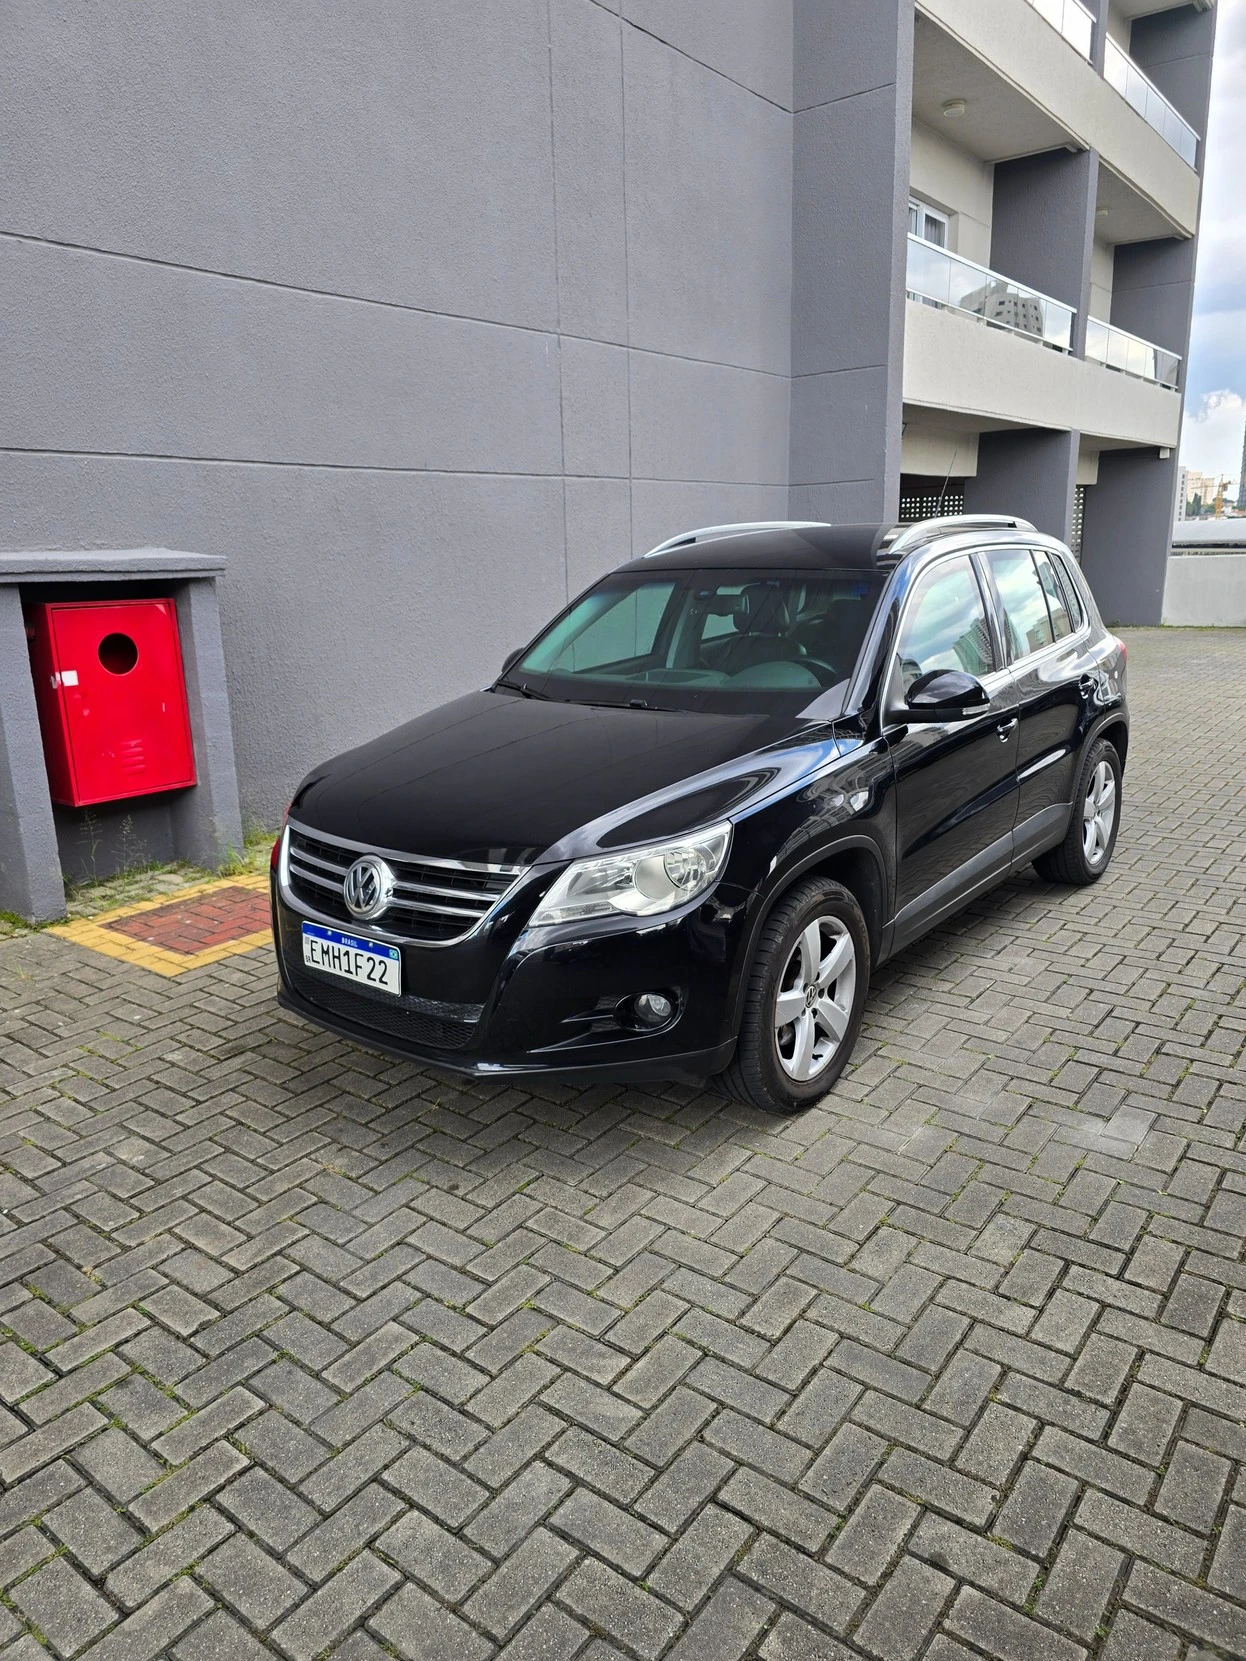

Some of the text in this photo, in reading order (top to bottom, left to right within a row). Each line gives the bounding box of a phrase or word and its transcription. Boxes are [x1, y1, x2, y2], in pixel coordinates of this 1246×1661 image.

[348, 864, 379, 911] VW
[310, 939, 388, 985] EMH1F22
[341, 937, 358, 948] BRASIL
